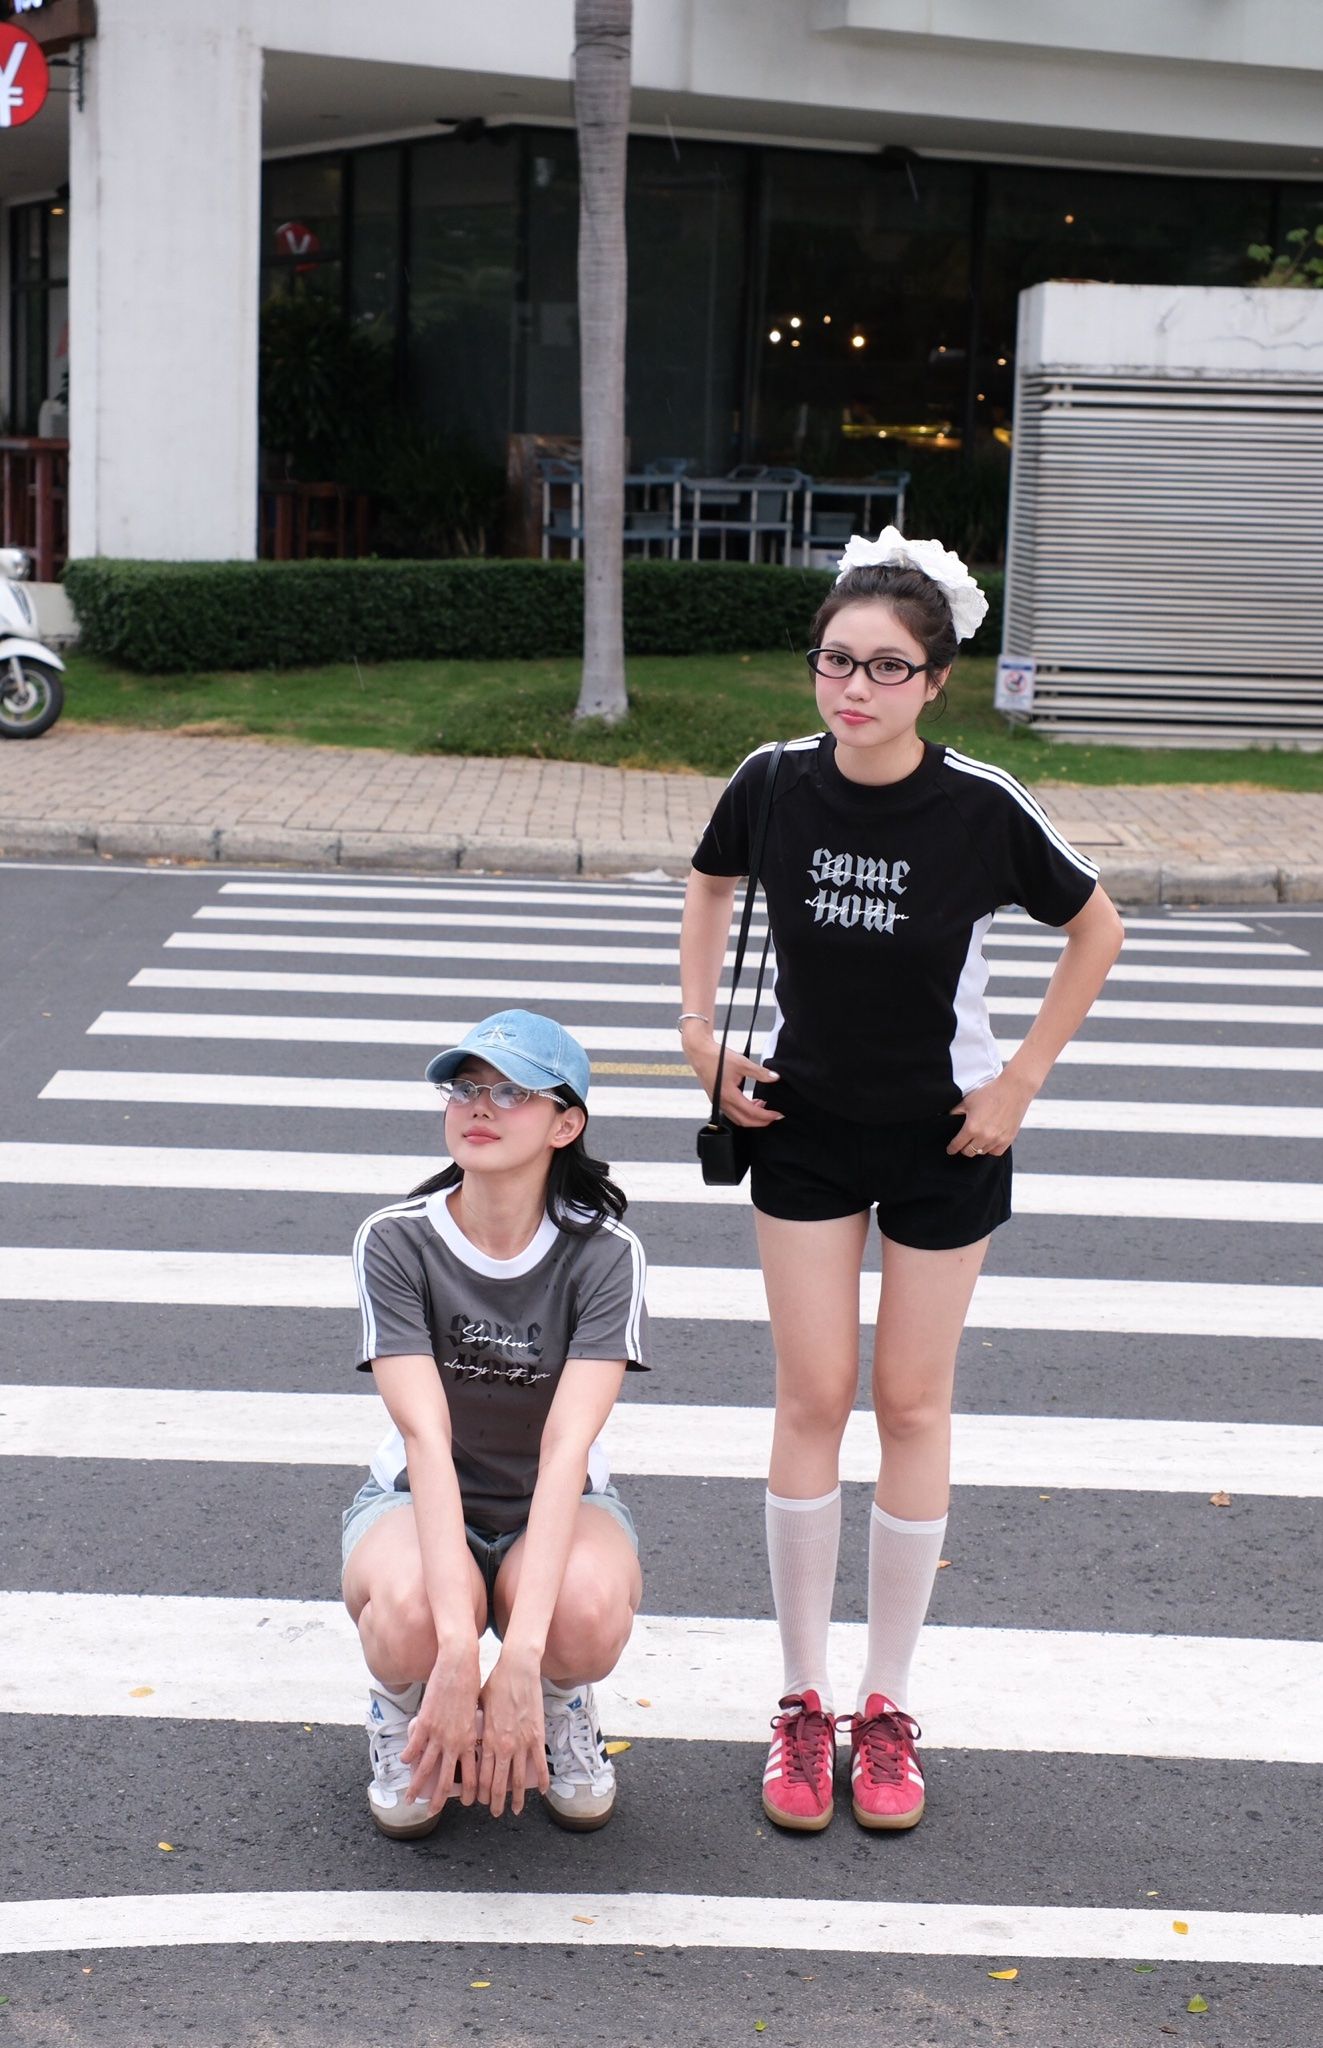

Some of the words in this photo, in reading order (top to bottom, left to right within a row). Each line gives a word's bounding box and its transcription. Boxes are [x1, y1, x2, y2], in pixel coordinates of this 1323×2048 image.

[462, 1324, 534, 1348] Somehow
[444, 1359, 490, 1379] always
[493, 1367, 528, 1381] with
[524, 1372, 551, 1385] you
